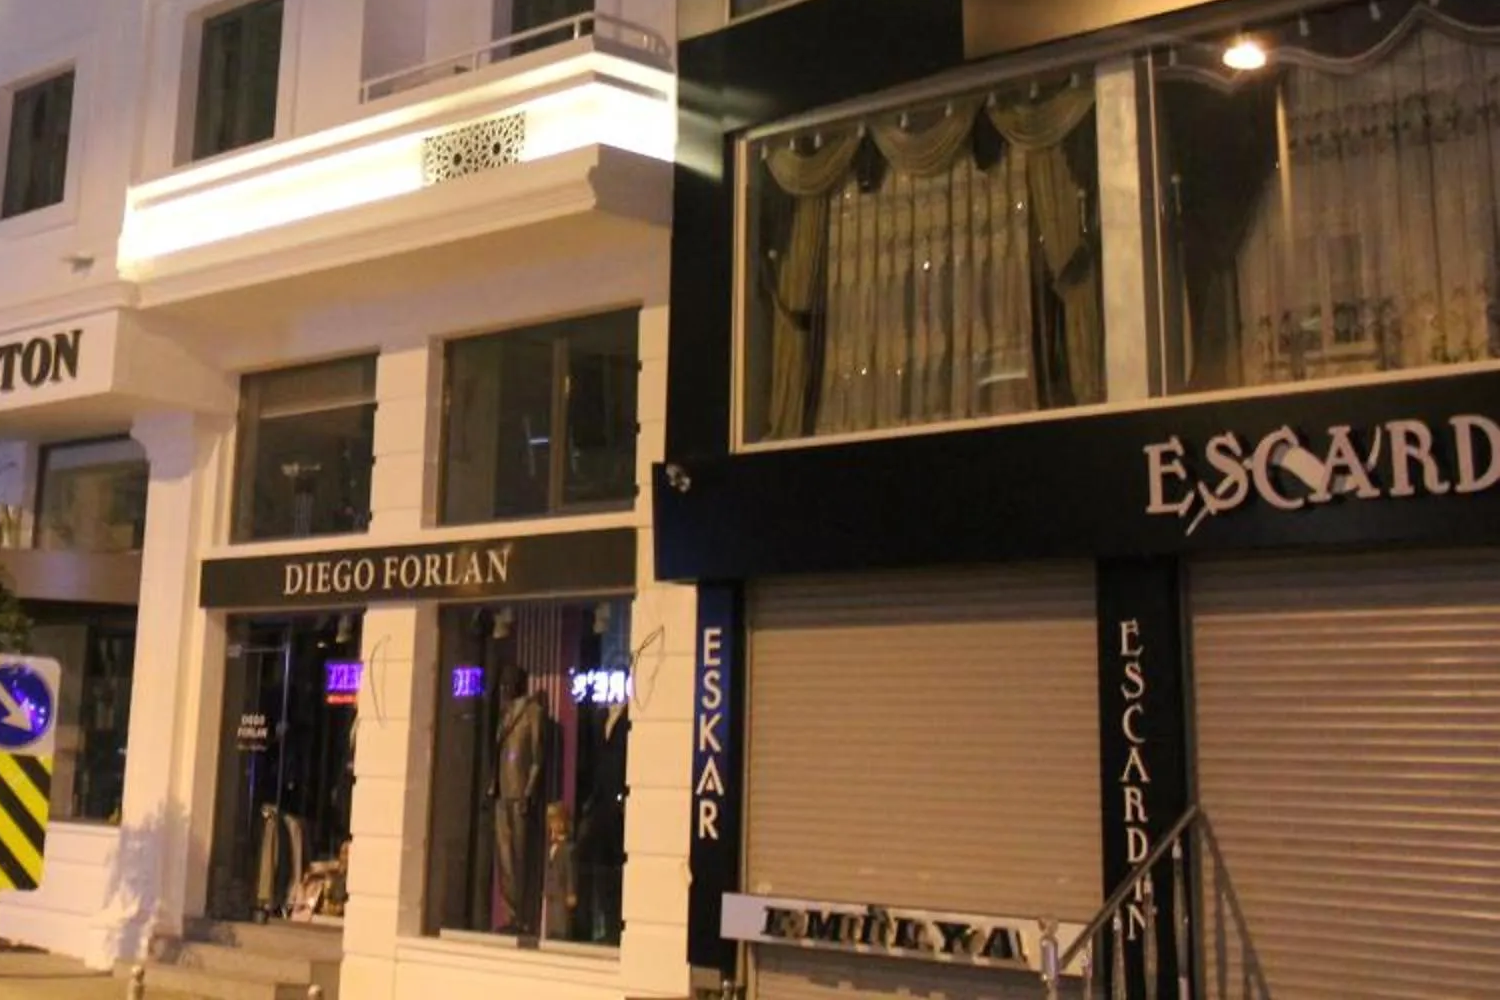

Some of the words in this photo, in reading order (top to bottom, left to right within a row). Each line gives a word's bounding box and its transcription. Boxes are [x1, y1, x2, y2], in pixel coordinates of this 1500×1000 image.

[1143, 414, 1500, 518] ESCARD
[284, 558, 373, 595] DIEGO
[383, 545, 512, 590] FORLAN
[696, 627, 724, 840] ESKAR
